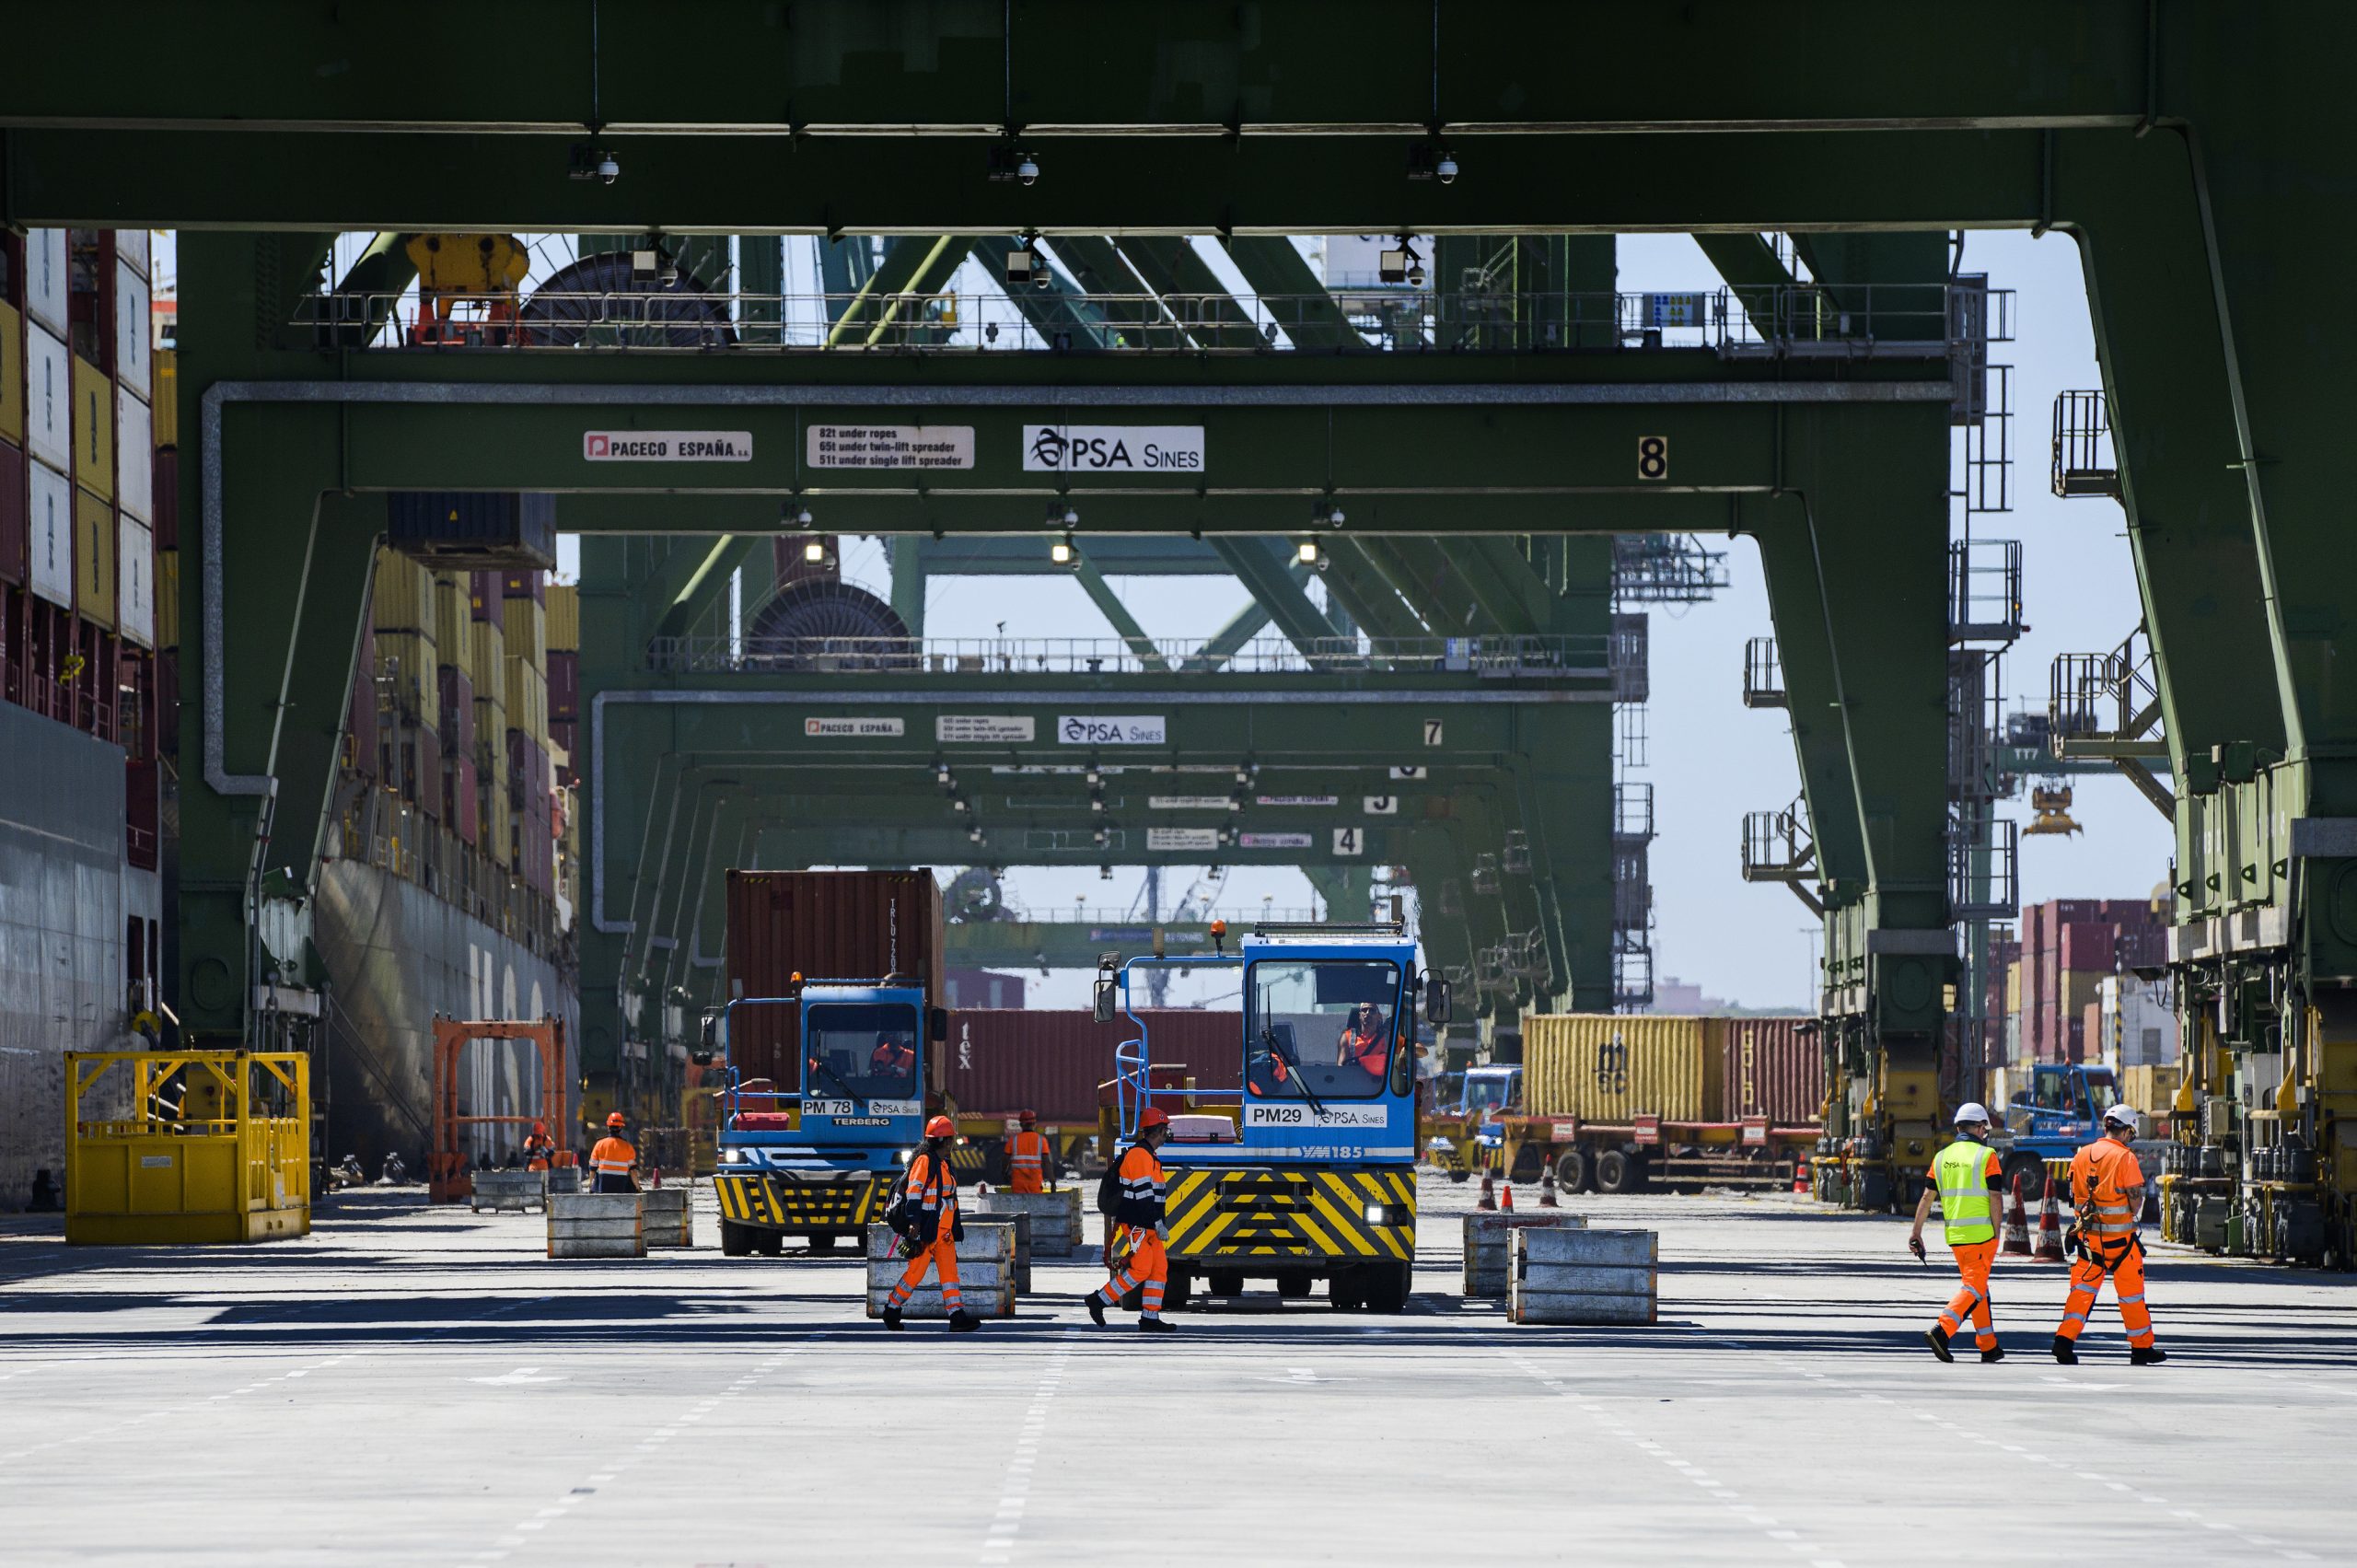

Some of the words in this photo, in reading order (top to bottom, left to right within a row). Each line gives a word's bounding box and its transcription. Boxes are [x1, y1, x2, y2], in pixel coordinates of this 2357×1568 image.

[819, 428, 836, 438] 82t
[839, 428, 867, 438] under
[870, 429, 897, 440] ropes
[610, 442, 667, 457] PACECO
[839, 442, 867, 451] under
[870, 442, 910, 451] twin-lift
[912, 442, 956, 454] spreader
[1072, 438, 1133, 468] PSA
[819, 455, 836, 465] 51t
[839, 455, 867, 465] under
[869, 455, 900, 467] single
[901, 455, 916, 465] lift
[919, 455, 962, 468] spreader
[1641, 437, 1666, 477] 8
[1087, 724, 1123, 741] PSA
[1426, 721, 1441, 744] 7
[1341, 829, 1355, 852] 4
[804, 1101, 825, 1114] PM
[832, 1101, 852, 1114] 78
[882, 1105, 900, 1114] PSA
[833, 1118, 890, 1126] TERBERG
[1253, 1109, 1302, 1122] PM29
[1334, 1112, 1358, 1124] PSA
